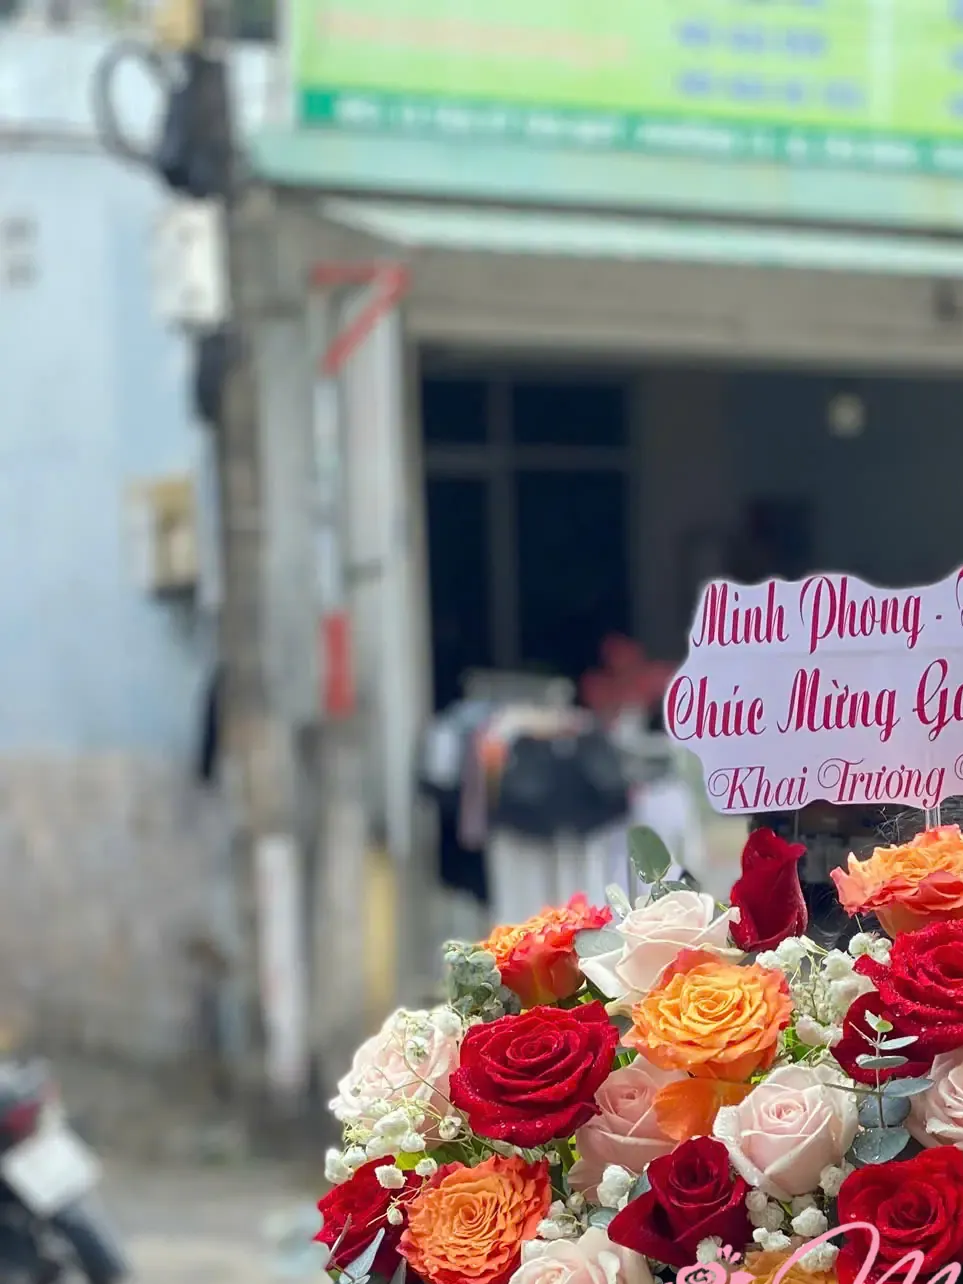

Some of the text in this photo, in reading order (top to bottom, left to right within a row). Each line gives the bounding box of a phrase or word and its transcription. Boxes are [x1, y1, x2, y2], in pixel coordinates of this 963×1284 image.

[692, 581, 789, 648] Minh
[799, 576, 926, 655] Phong
[668, 675, 767, 741] Chúc
[776, 667, 901, 743] Mừng
[707, 765, 809, 810] Khai
[817, 757, 946, 809] Trương
